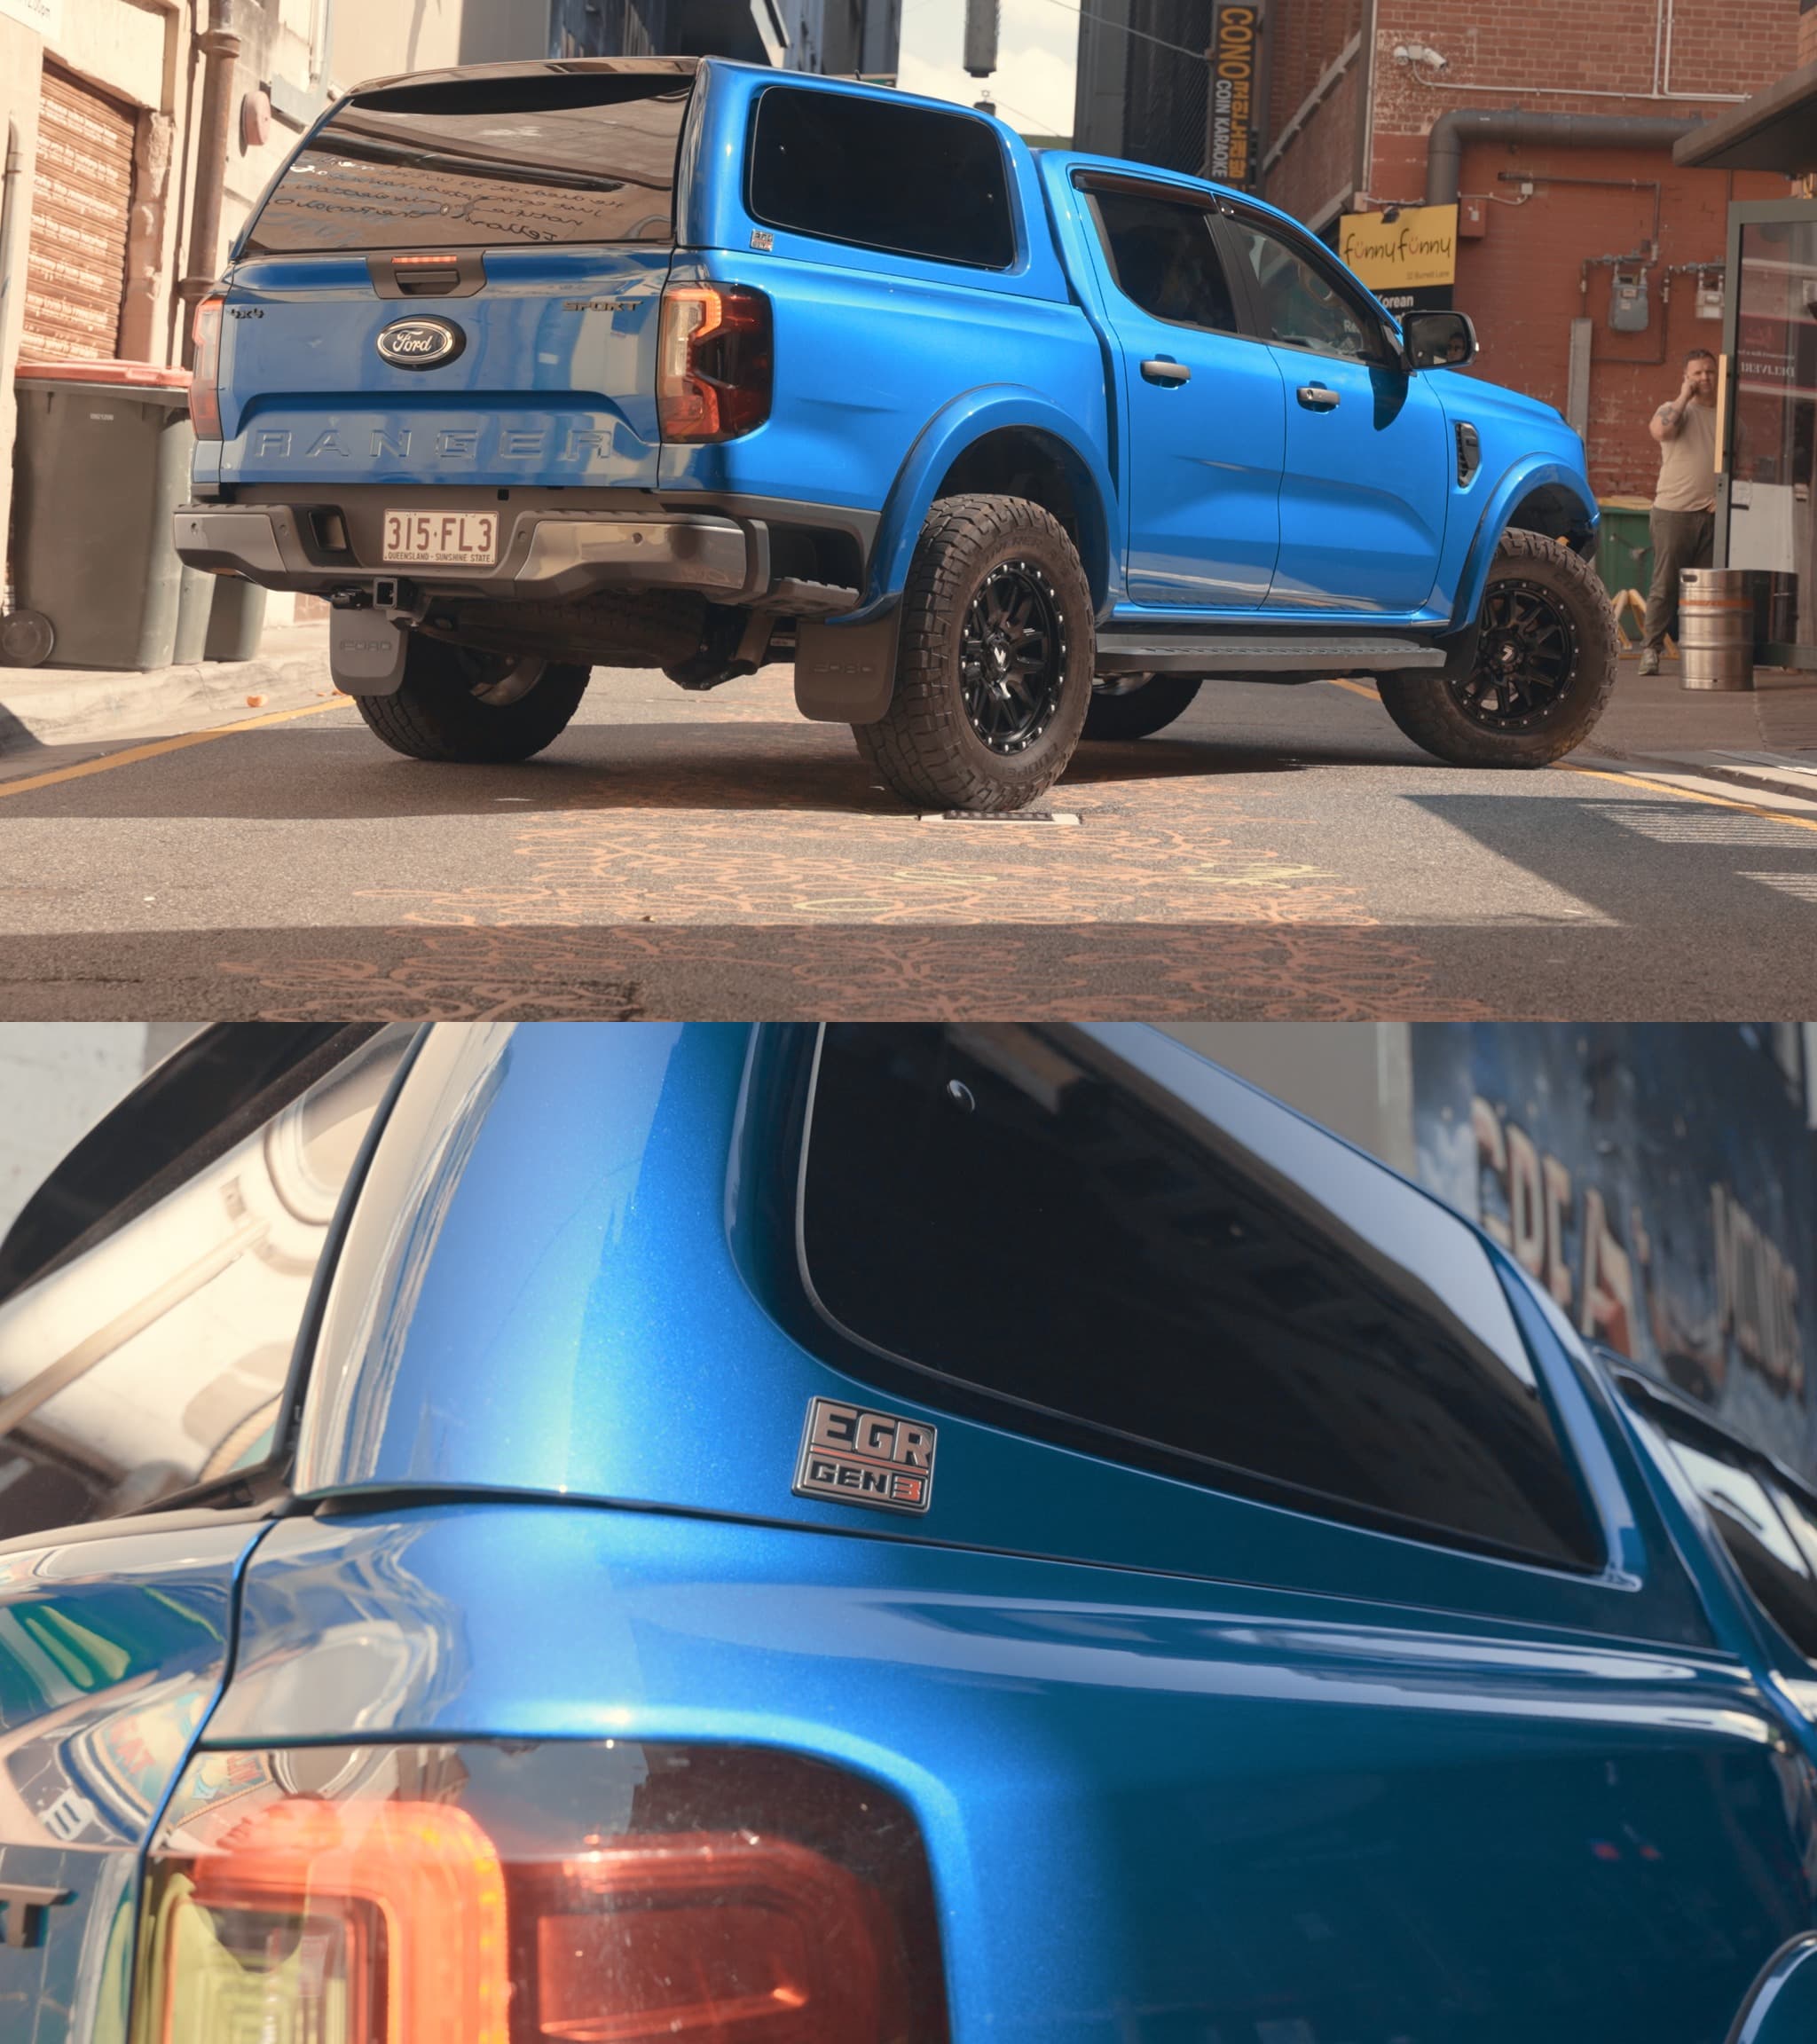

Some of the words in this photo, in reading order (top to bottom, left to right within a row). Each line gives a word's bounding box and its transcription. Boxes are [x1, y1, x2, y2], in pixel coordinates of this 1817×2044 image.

[1217, 7, 1254, 80] CONO
[1215, 80, 1232, 114] COIN
[1212, 117, 1231, 177] KARAOKE
[392, 329, 433, 352] Ford
[254, 428, 614, 459] RANGER
[388, 552, 429, 561] QUEENSLAND
[436, 554, 468, 562] SUNSHINE
[470, 554, 492, 563] STATE
[812, 1401, 932, 1468] EGR
